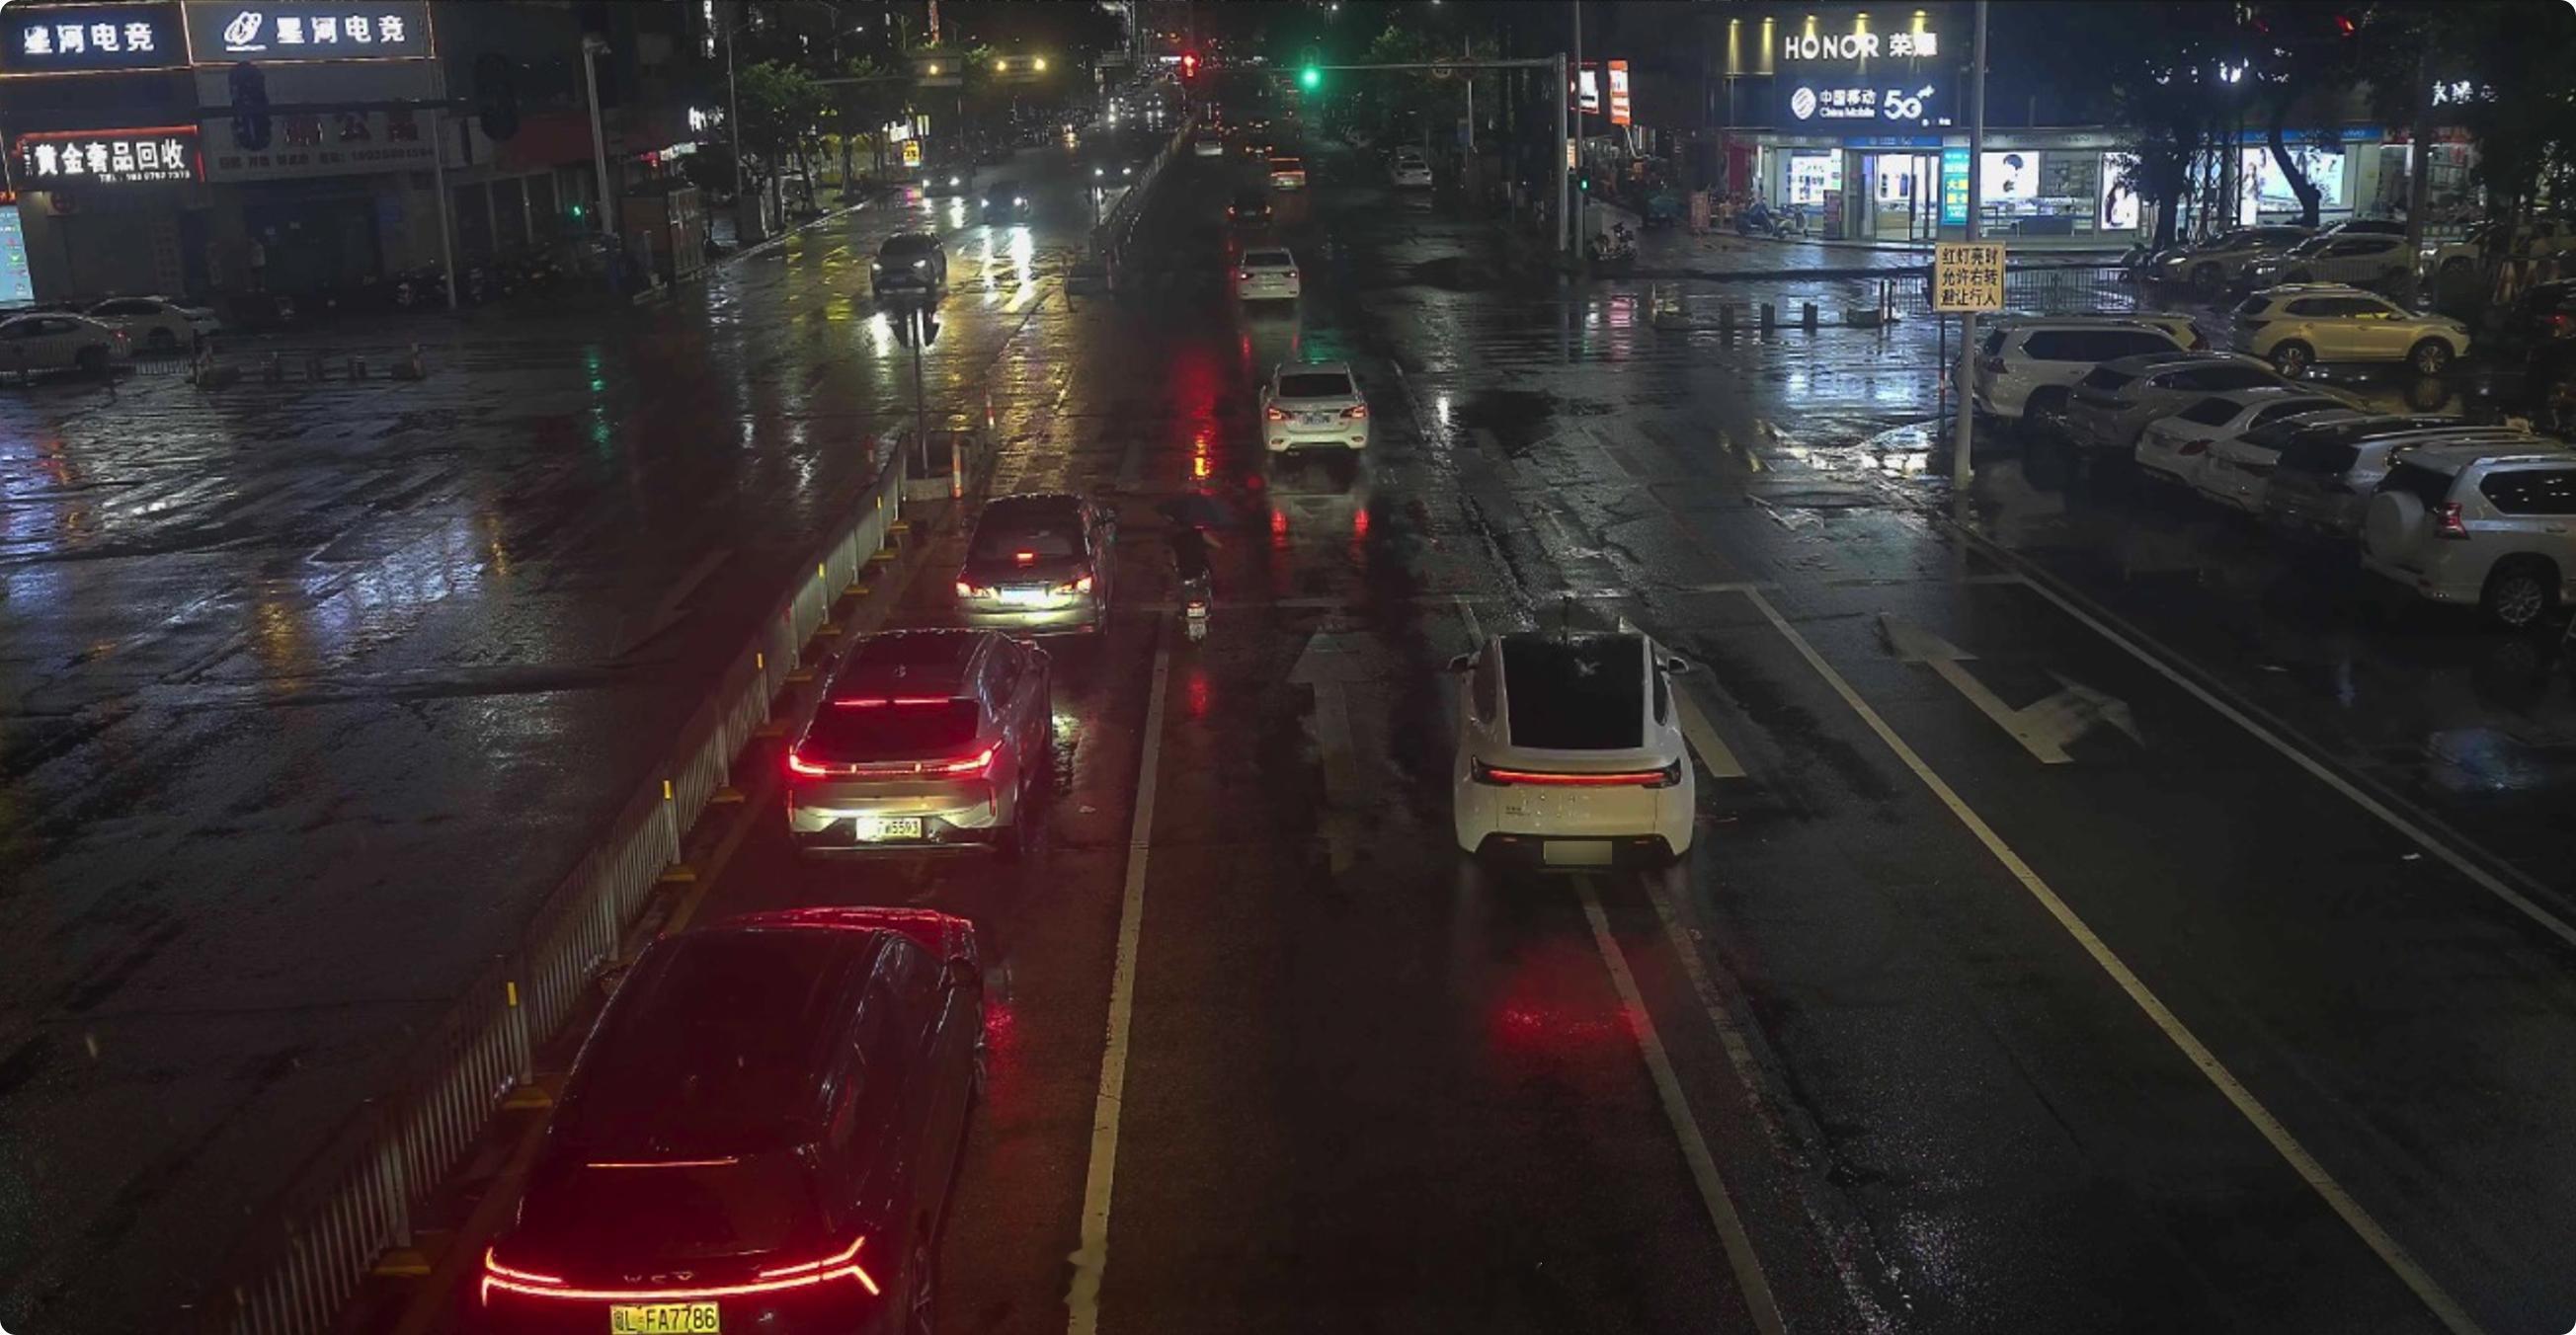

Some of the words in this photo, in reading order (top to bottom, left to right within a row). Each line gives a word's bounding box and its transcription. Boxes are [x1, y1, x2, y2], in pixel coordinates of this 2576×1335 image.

[24, 22, 155, 54] 星河电竞
[277, 15, 406, 43] 星河电竞
[1785, 33, 1880, 59] HONOR
[1819, 89, 1876, 106] 中国移动
[35, 138, 185, 176] 黄金奢品回收
[1942, 246, 1998, 265] 红灯亮时
[1942, 267, 1998, 286] 允许右转
[1941, 287, 1997, 307] 避让行人
